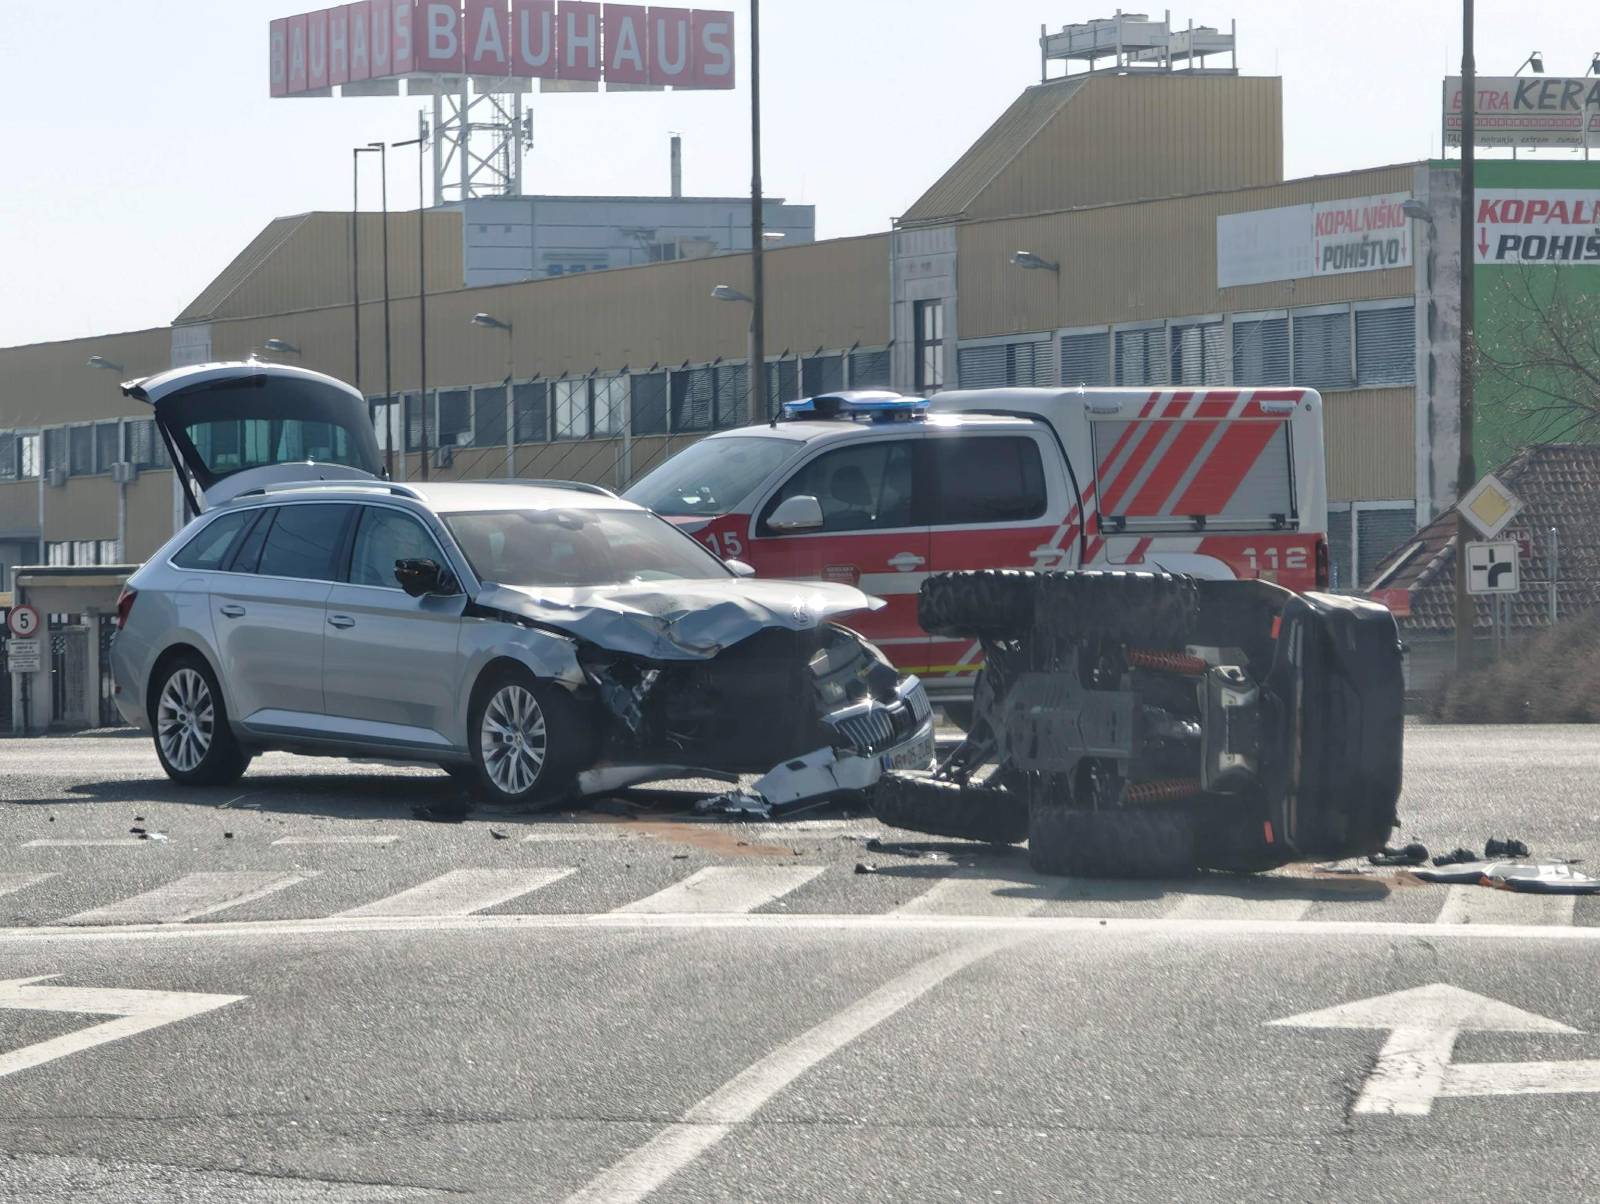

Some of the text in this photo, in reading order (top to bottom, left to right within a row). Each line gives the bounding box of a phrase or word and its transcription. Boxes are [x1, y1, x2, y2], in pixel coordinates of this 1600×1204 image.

[271, 3, 410, 83] BAUHAUS
[427, 3, 731, 76] BAUHAUS
[1452, 79, 1600, 111] ETRA KERA
[1315, 199, 1406, 237] KOPALNIŠKO
[1322, 235, 1400, 271] POHIŠTVO
[705, 531, 743, 557] 15
[1242, 546, 1308, 569] 112
[20, 613, 29, 629] 5
